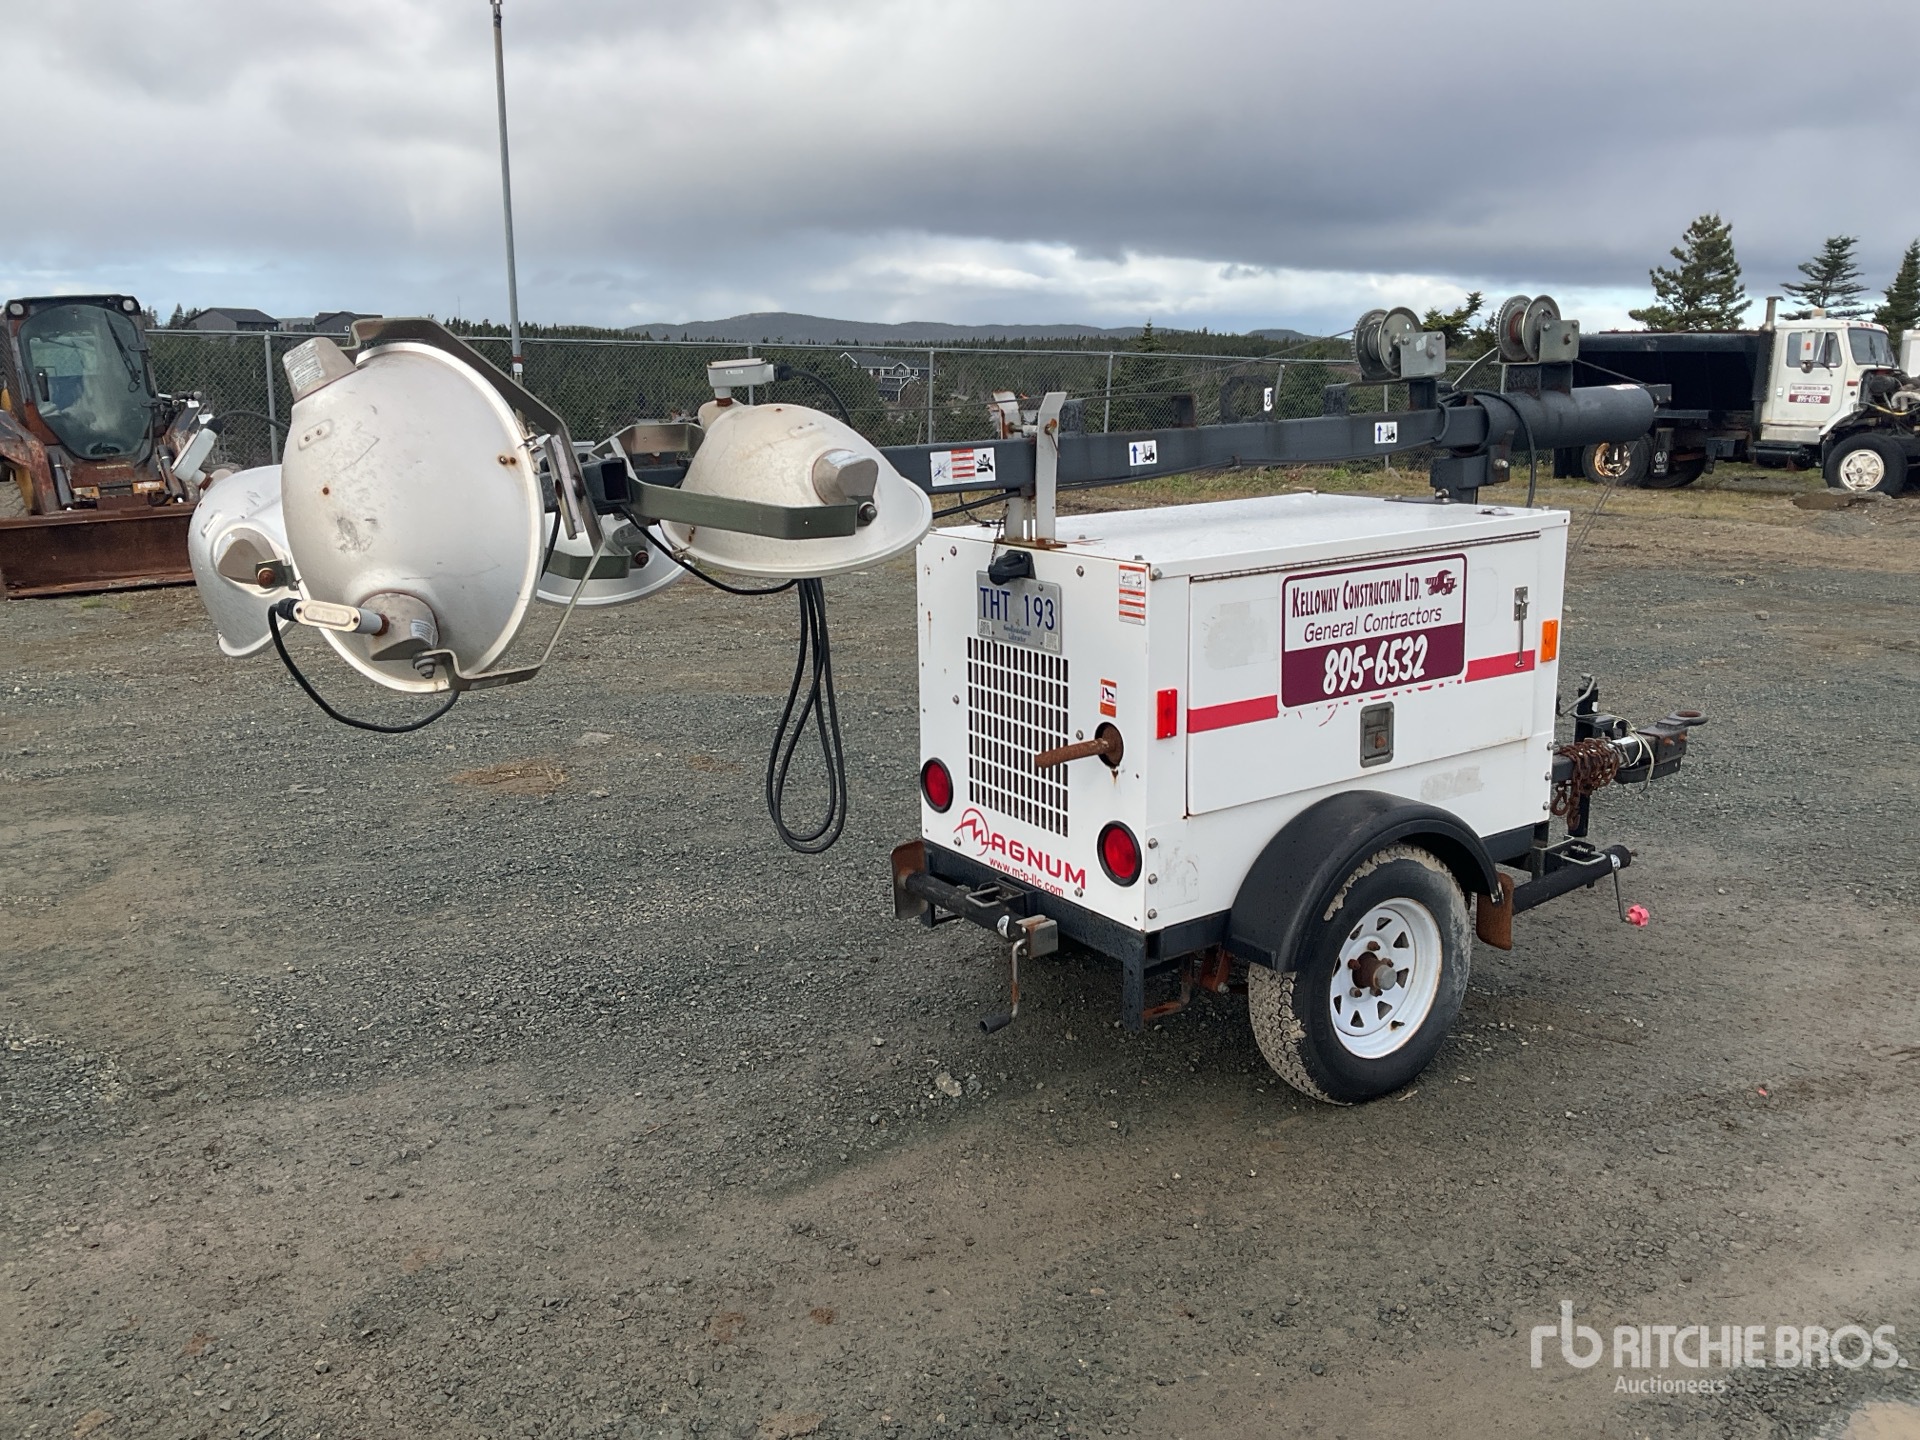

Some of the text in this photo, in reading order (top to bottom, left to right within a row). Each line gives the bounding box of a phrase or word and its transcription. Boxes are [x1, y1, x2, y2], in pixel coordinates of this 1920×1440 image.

[980, 587, 1011, 622] THT
[1024, 594, 1056, 631] 193
[1343, 578, 1402, 611] CONSTRUCTION
[1304, 606, 1442, 643] General Contractors
[1322, 634, 1428, 695] 895-6532
